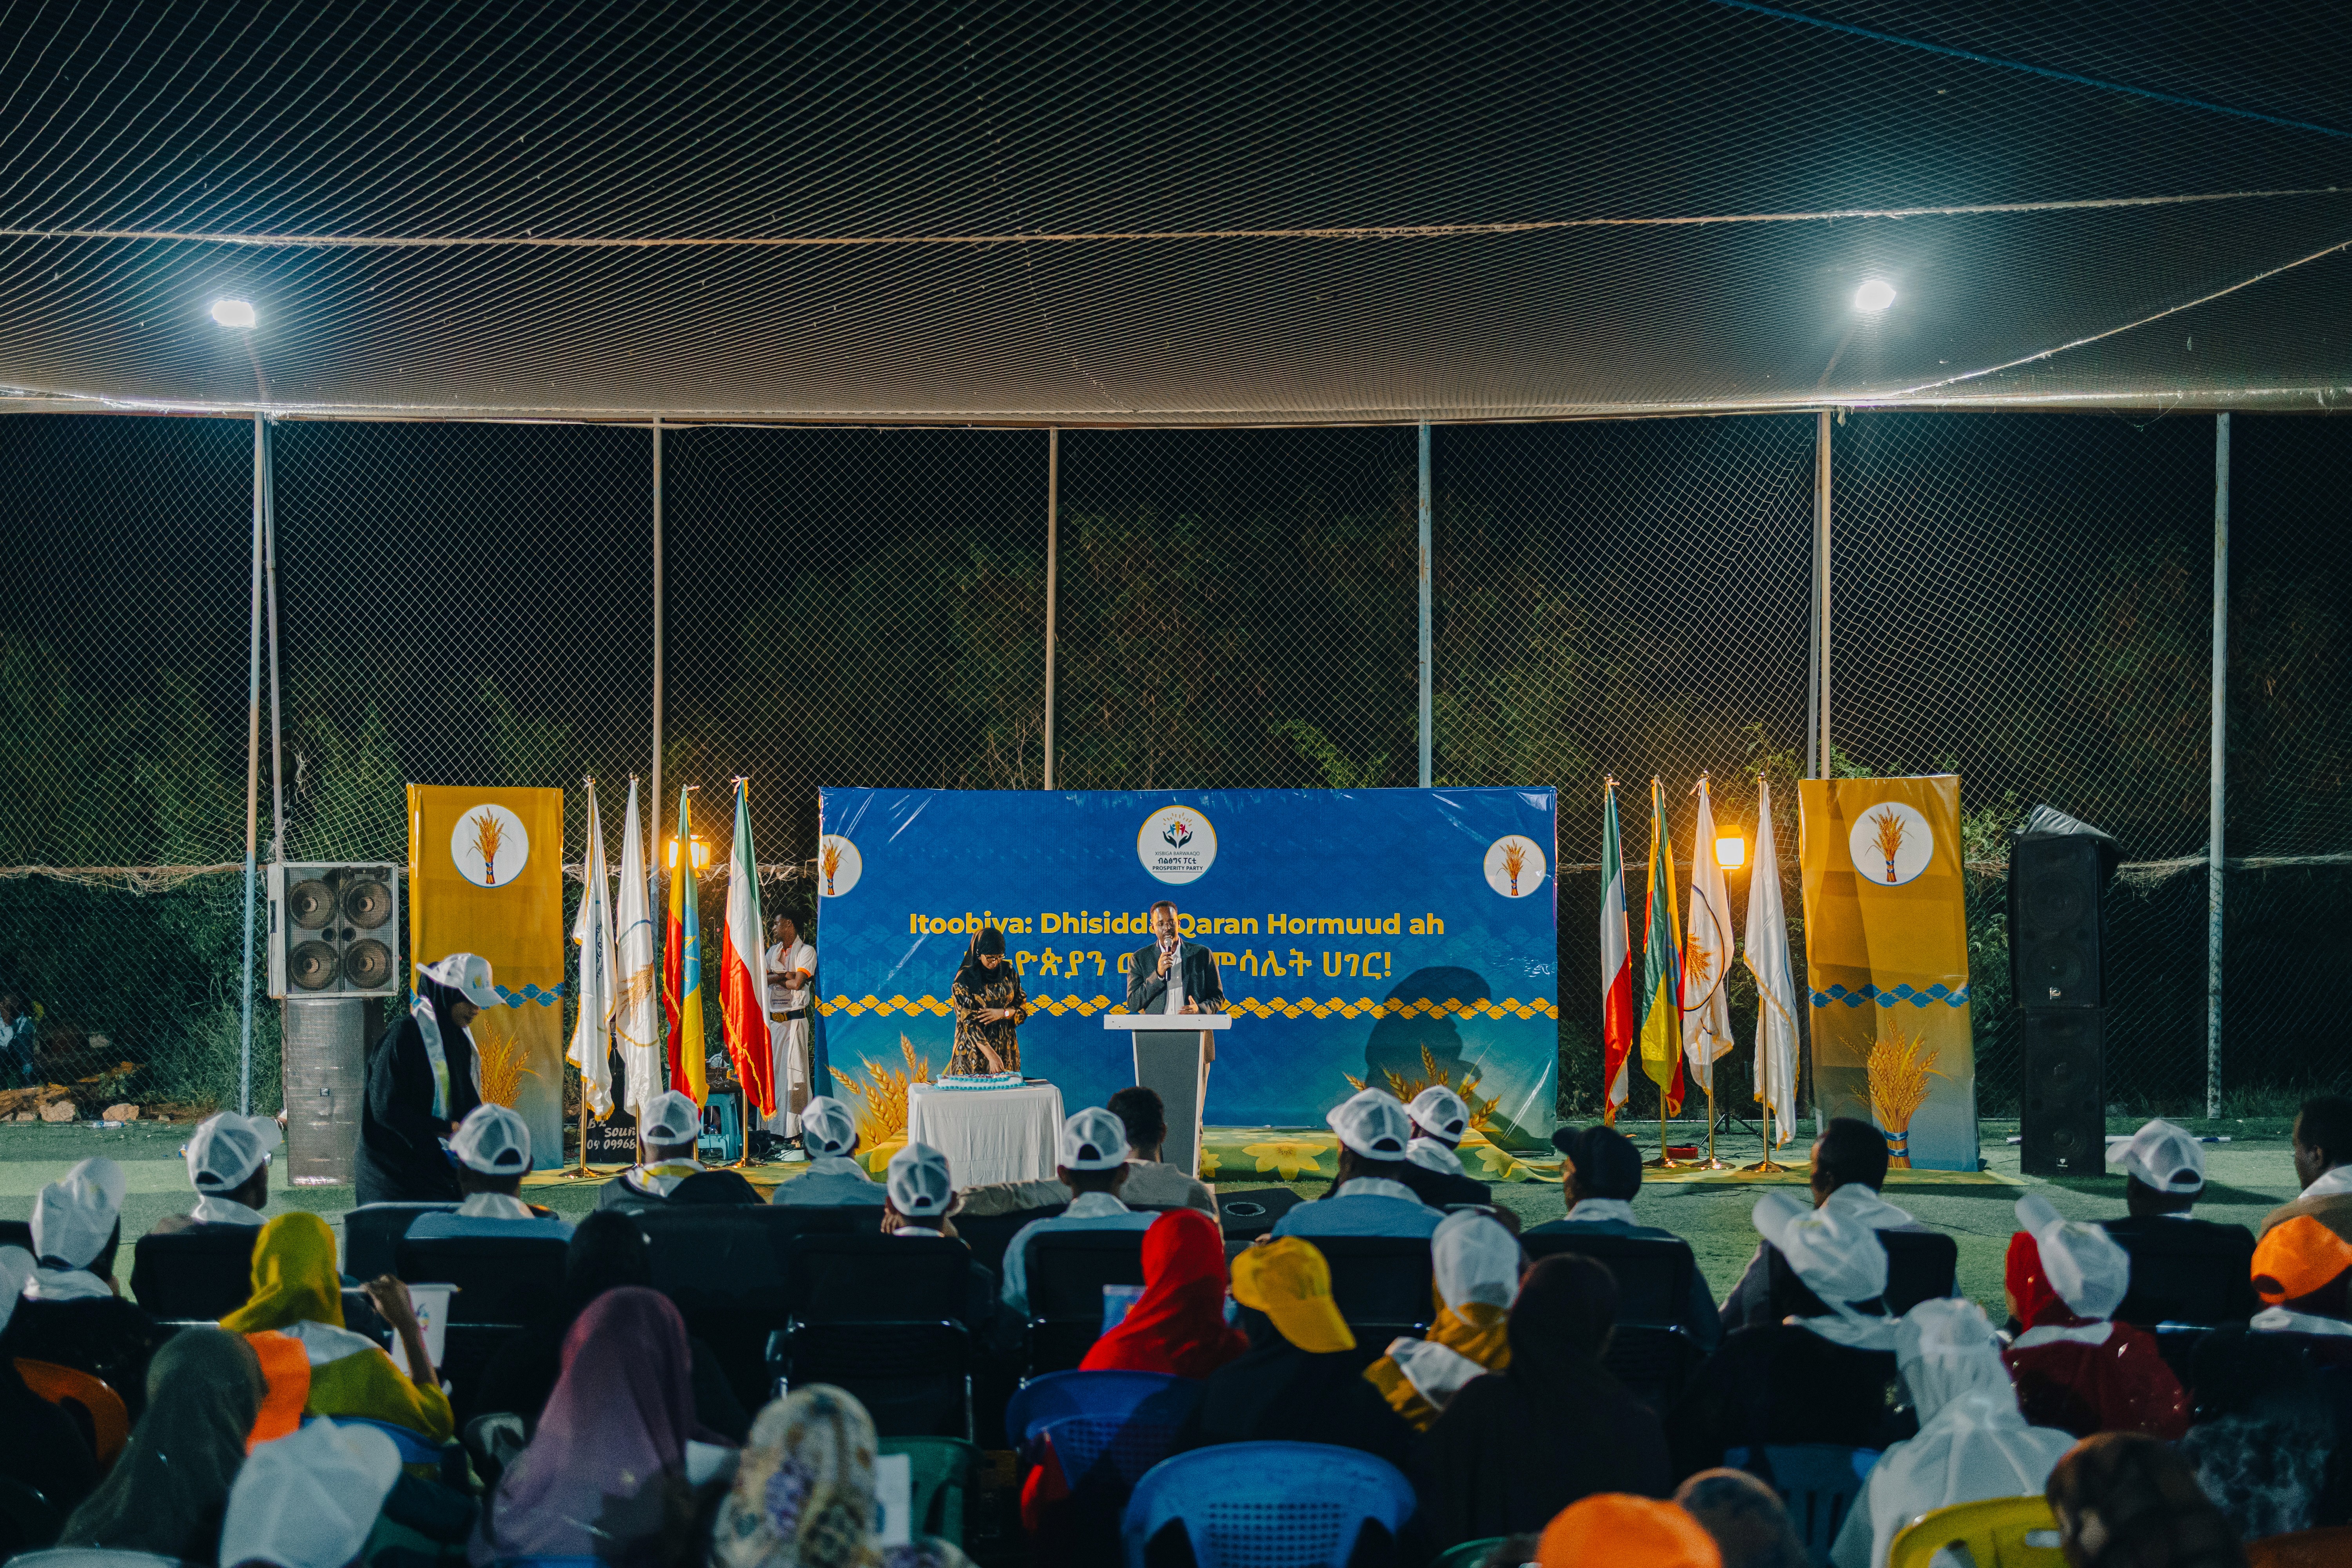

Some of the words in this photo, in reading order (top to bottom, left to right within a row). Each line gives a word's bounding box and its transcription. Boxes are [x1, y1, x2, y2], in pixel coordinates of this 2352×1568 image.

[1041, 911, 1156, 934] Dhisidd
[1177, 913, 1258, 938] Qaran
[1267, 913, 1401, 935] Hormuud
[1409, 913, 1445, 935] ah
[964, 947, 1106, 978] ዮጵያን
[1212, 948, 1312, 976] ምሳሌት
[1323, 951, 1391, 980] ሀገር!
[603, 1138, 636, 1150] 09968
